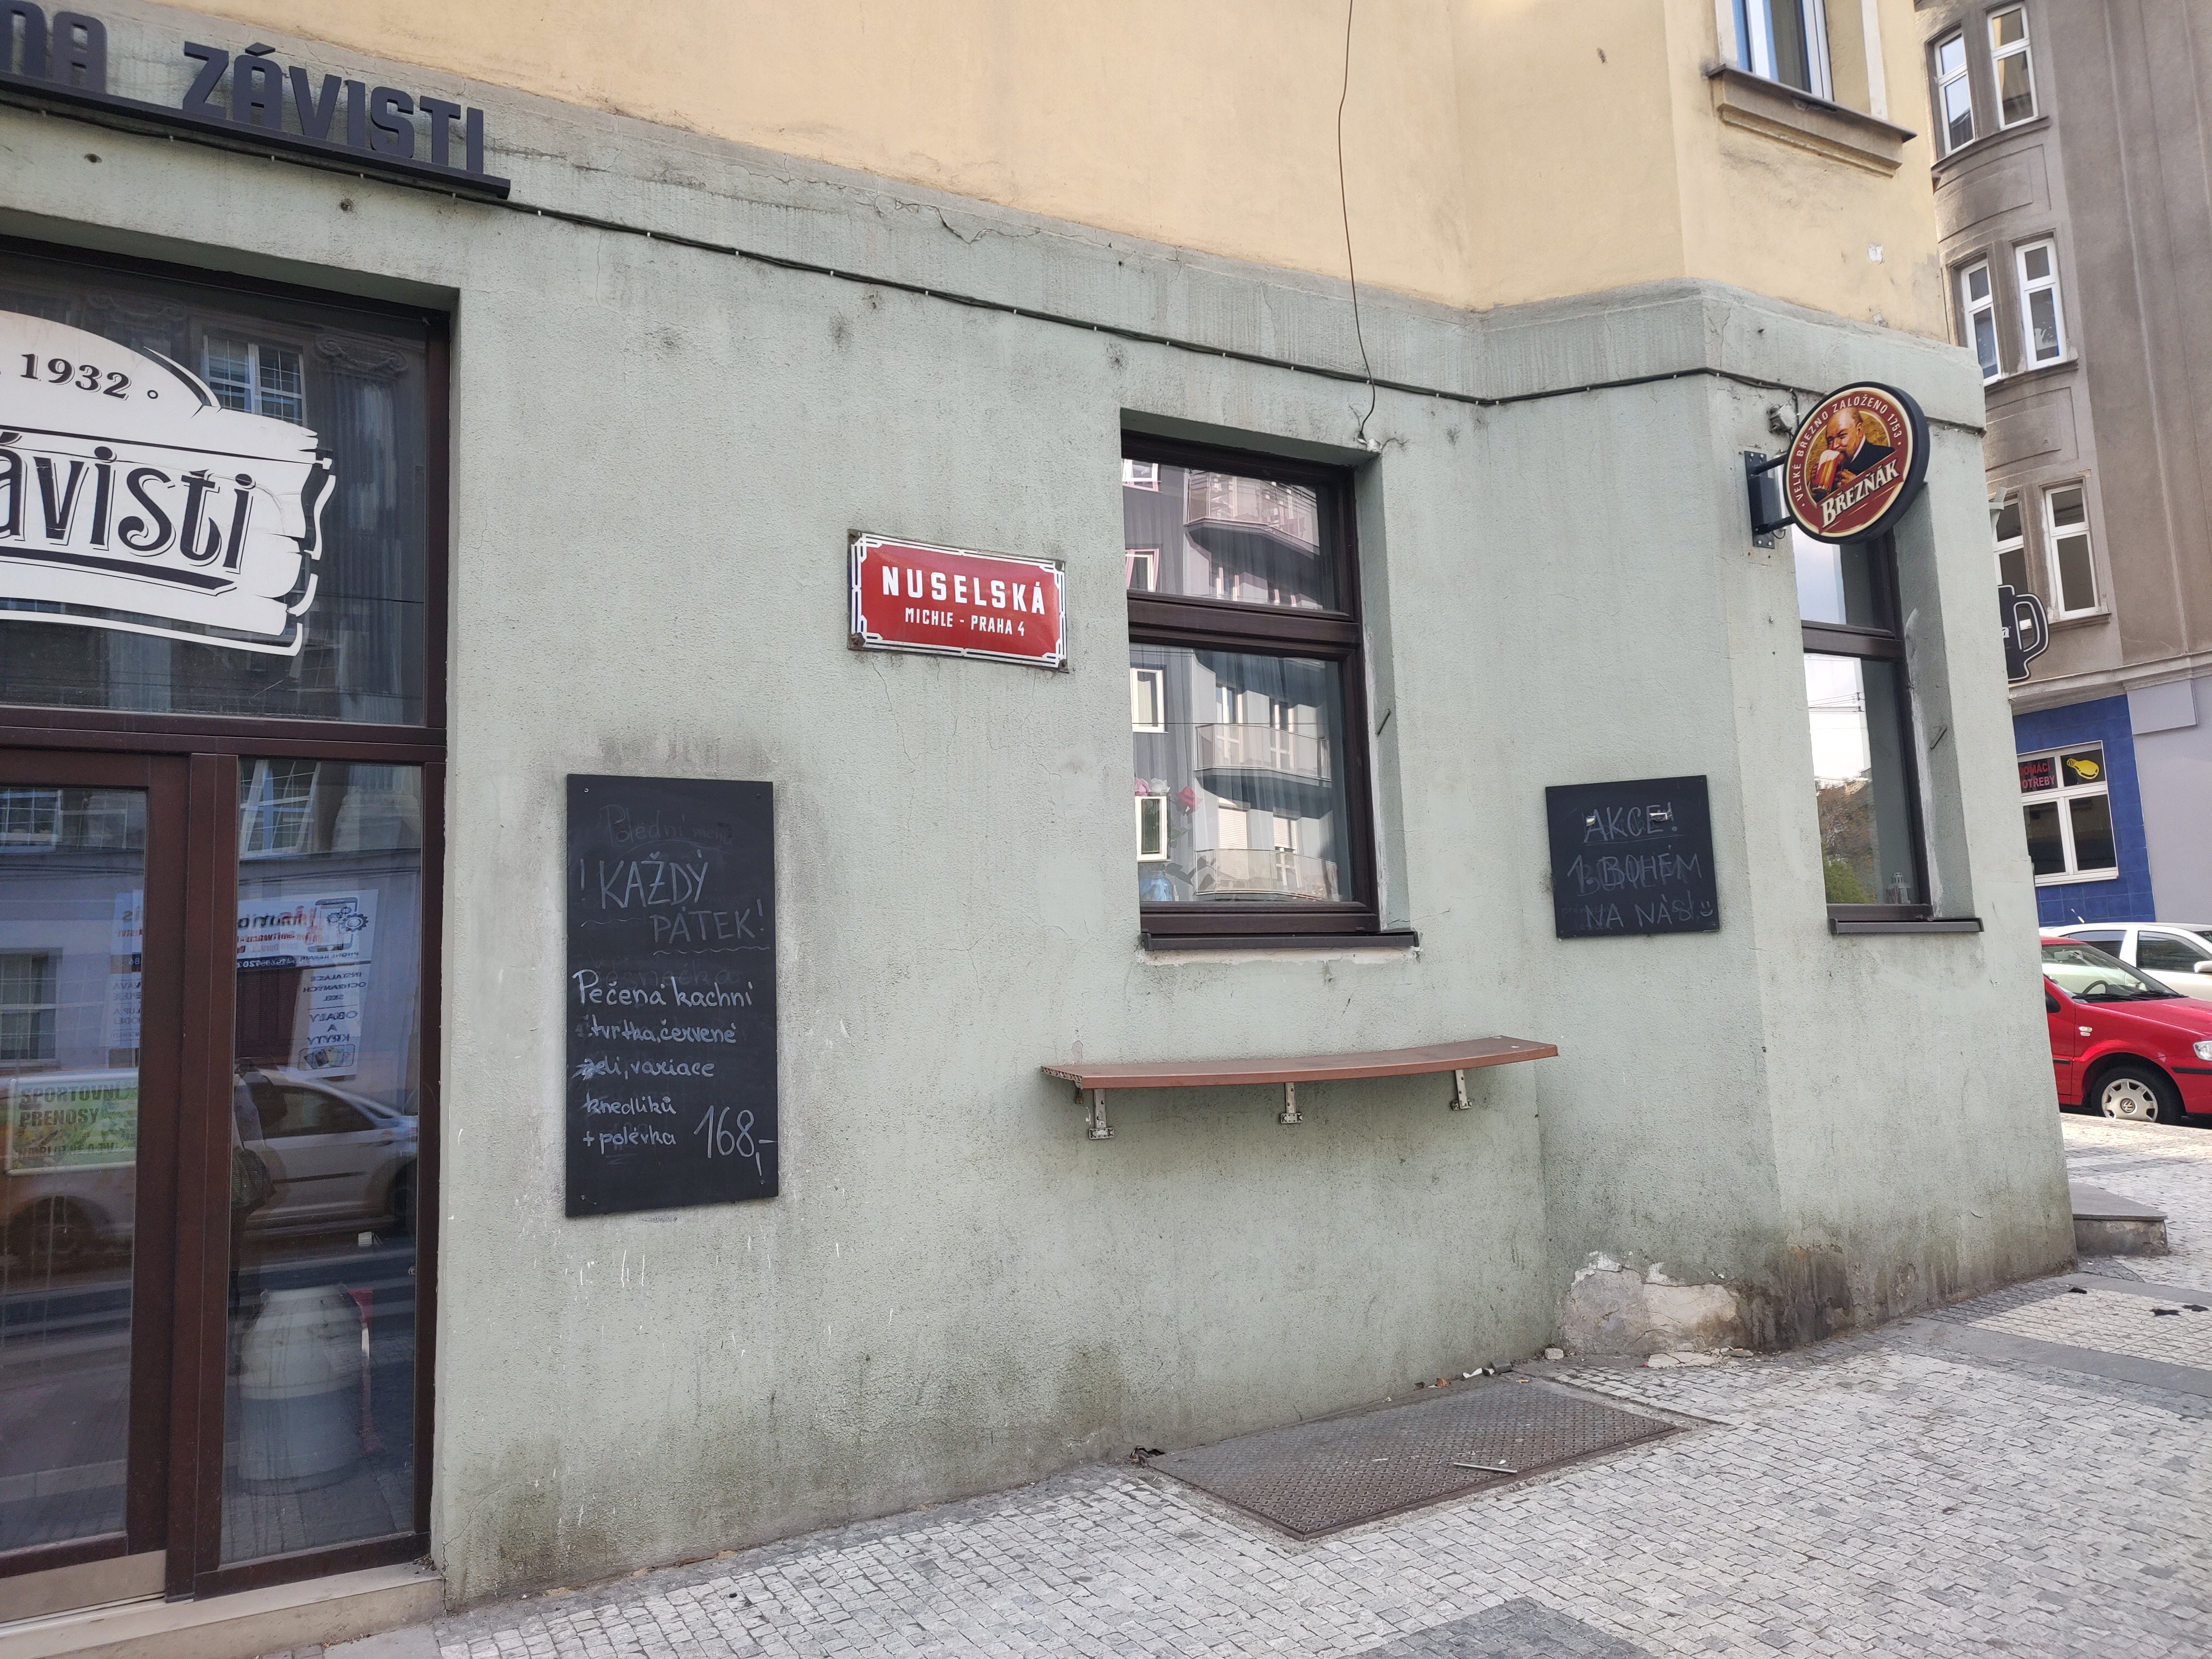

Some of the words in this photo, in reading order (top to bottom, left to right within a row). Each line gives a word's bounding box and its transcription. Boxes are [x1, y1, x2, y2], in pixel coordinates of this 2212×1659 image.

[182, 41, 484, 174] ZÁVISTI
[20, 353, 132, 400] 1932
[1832, 394, 1888, 414] ZALOŽENO
[1796, 411, 1829, 457] BŘEZNO
[1887, 414, 1902, 438] 1753
[1792, 463, 1804, 501] VELKÉ
[1820, 458, 1900, 529] BŘEZŇÁK
[881, 565, 1046, 615] NUSELSKÁ
[905, 607, 953, 628] MICHLE
[971, 615, 1013, 635] PRAHA
[1018, 621, 1025, 637] 4
[2021, 775, 2055, 789] OTŘEBY
[1583, 802, 1678, 843] AKCE!
[599, 849, 709, 909] KAŽDÝ
[1584, 903, 1624, 928] NA
[572, 969, 666, 1005] Pečená
[670, 976, 753, 1007] kachní
[630, 1058, 715, 1078] variace
[599, 1124, 677, 1155] polévka
